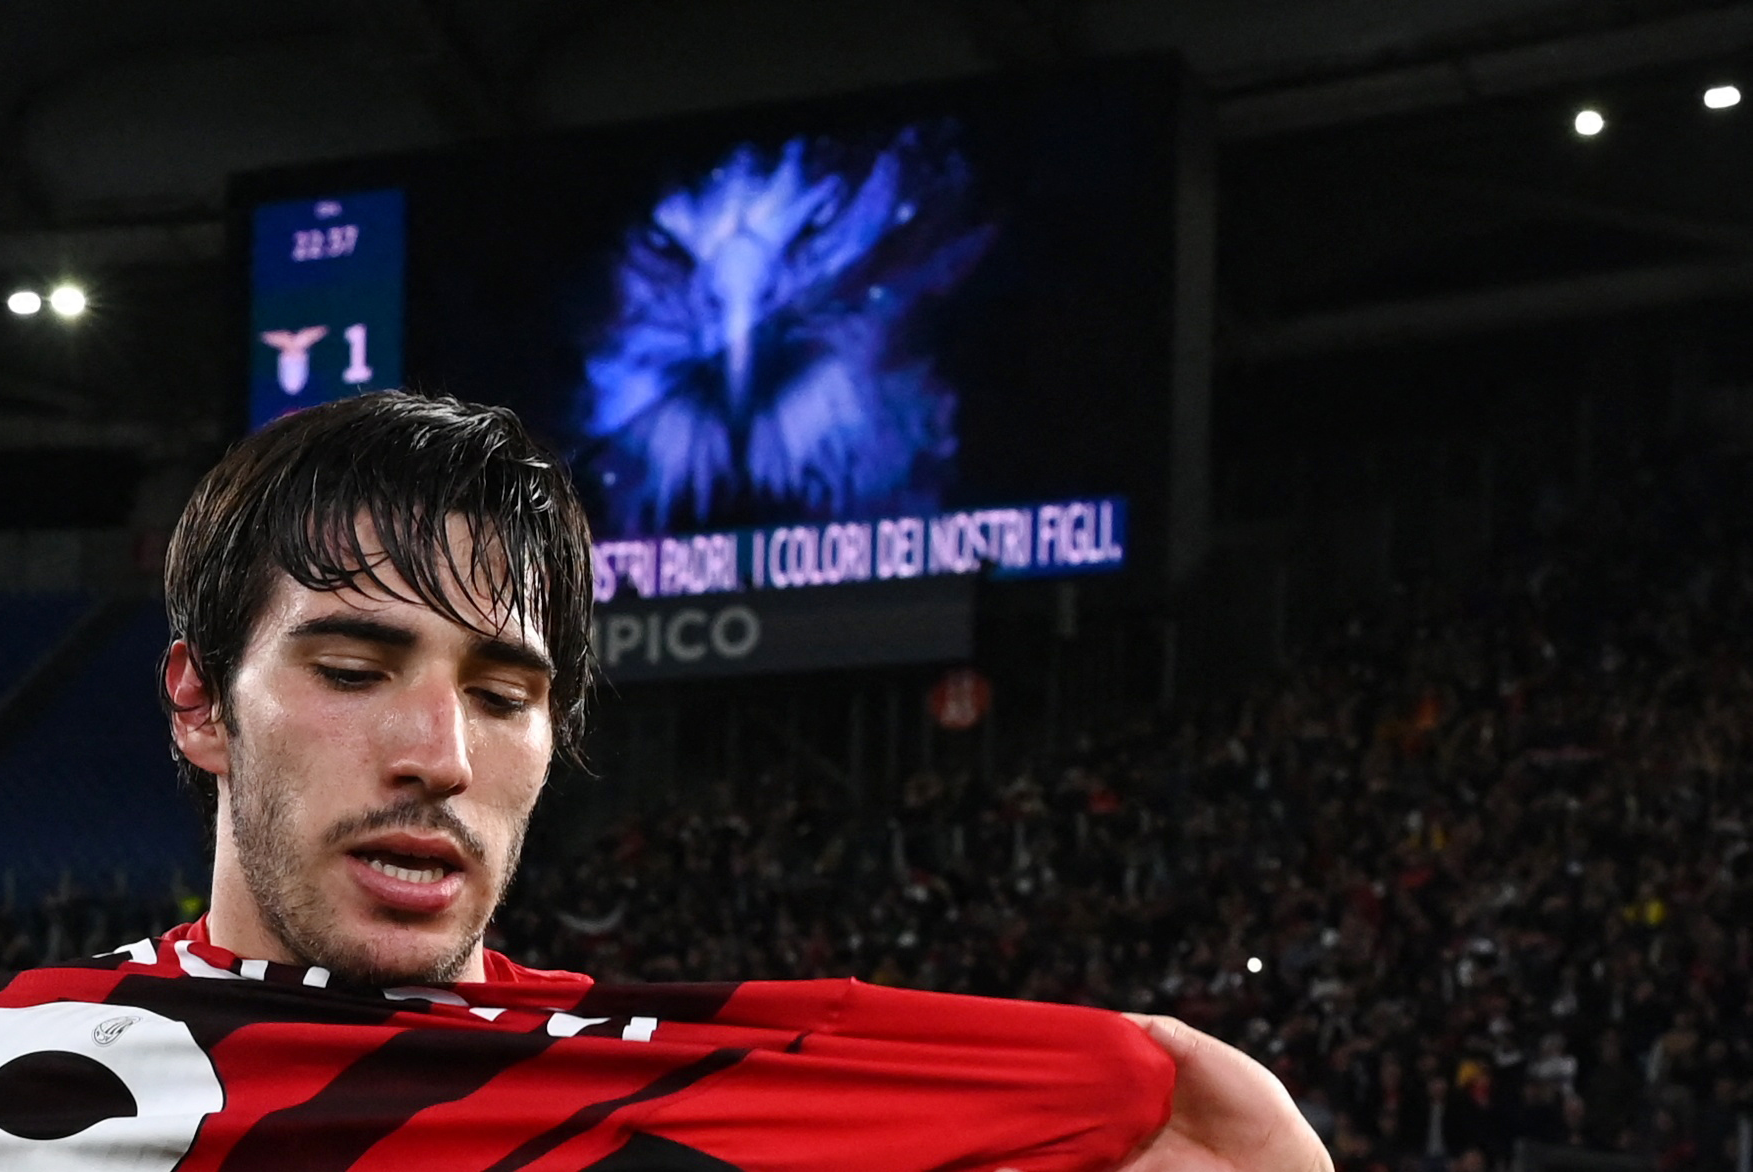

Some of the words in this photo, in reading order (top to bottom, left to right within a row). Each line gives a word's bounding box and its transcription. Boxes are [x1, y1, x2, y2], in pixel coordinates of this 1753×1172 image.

[342, 322, 373, 384] 1
[752, 529, 765, 590] I
[768, 520, 872, 589] COLORI
[875, 516, 925, 580] DEI
[928, 507, 1034, 574] NOSTRI
[592, 605, 762, 668] PICO
